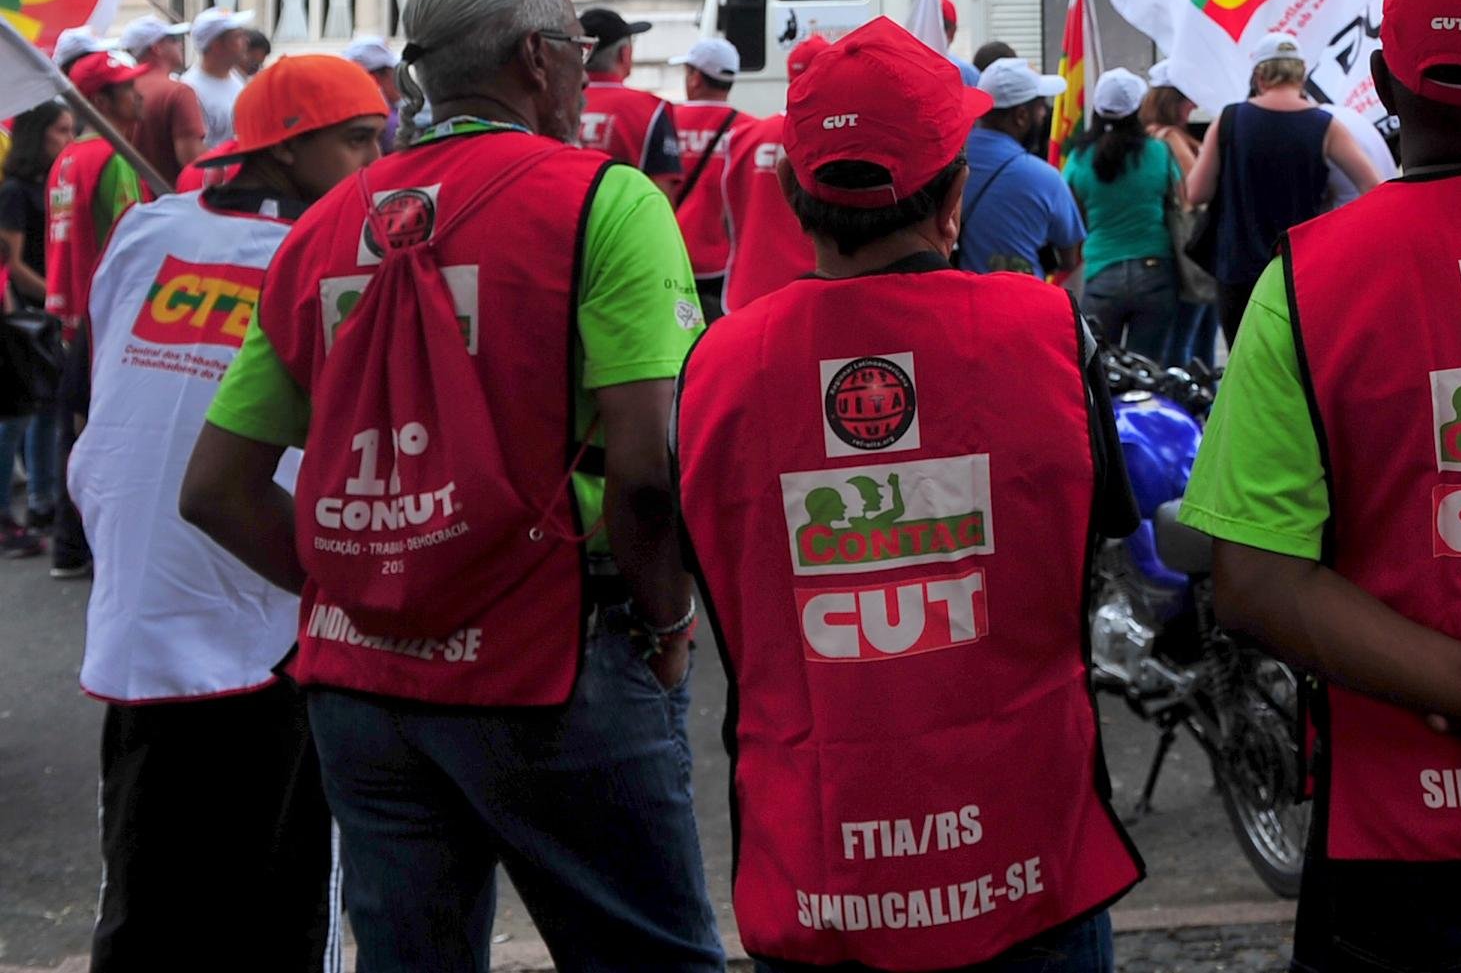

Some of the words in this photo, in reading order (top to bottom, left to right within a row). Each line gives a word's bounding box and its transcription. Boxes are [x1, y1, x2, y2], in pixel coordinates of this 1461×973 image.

[823, 113, 858, 129] CUT
[838, 392, 903, 415] UITA
[802, 572, 982, 659] CUT
[841, 805, 983, 860] FTIA/RS
[797, 856, 1044, 931] SINDICALIZE-SE
